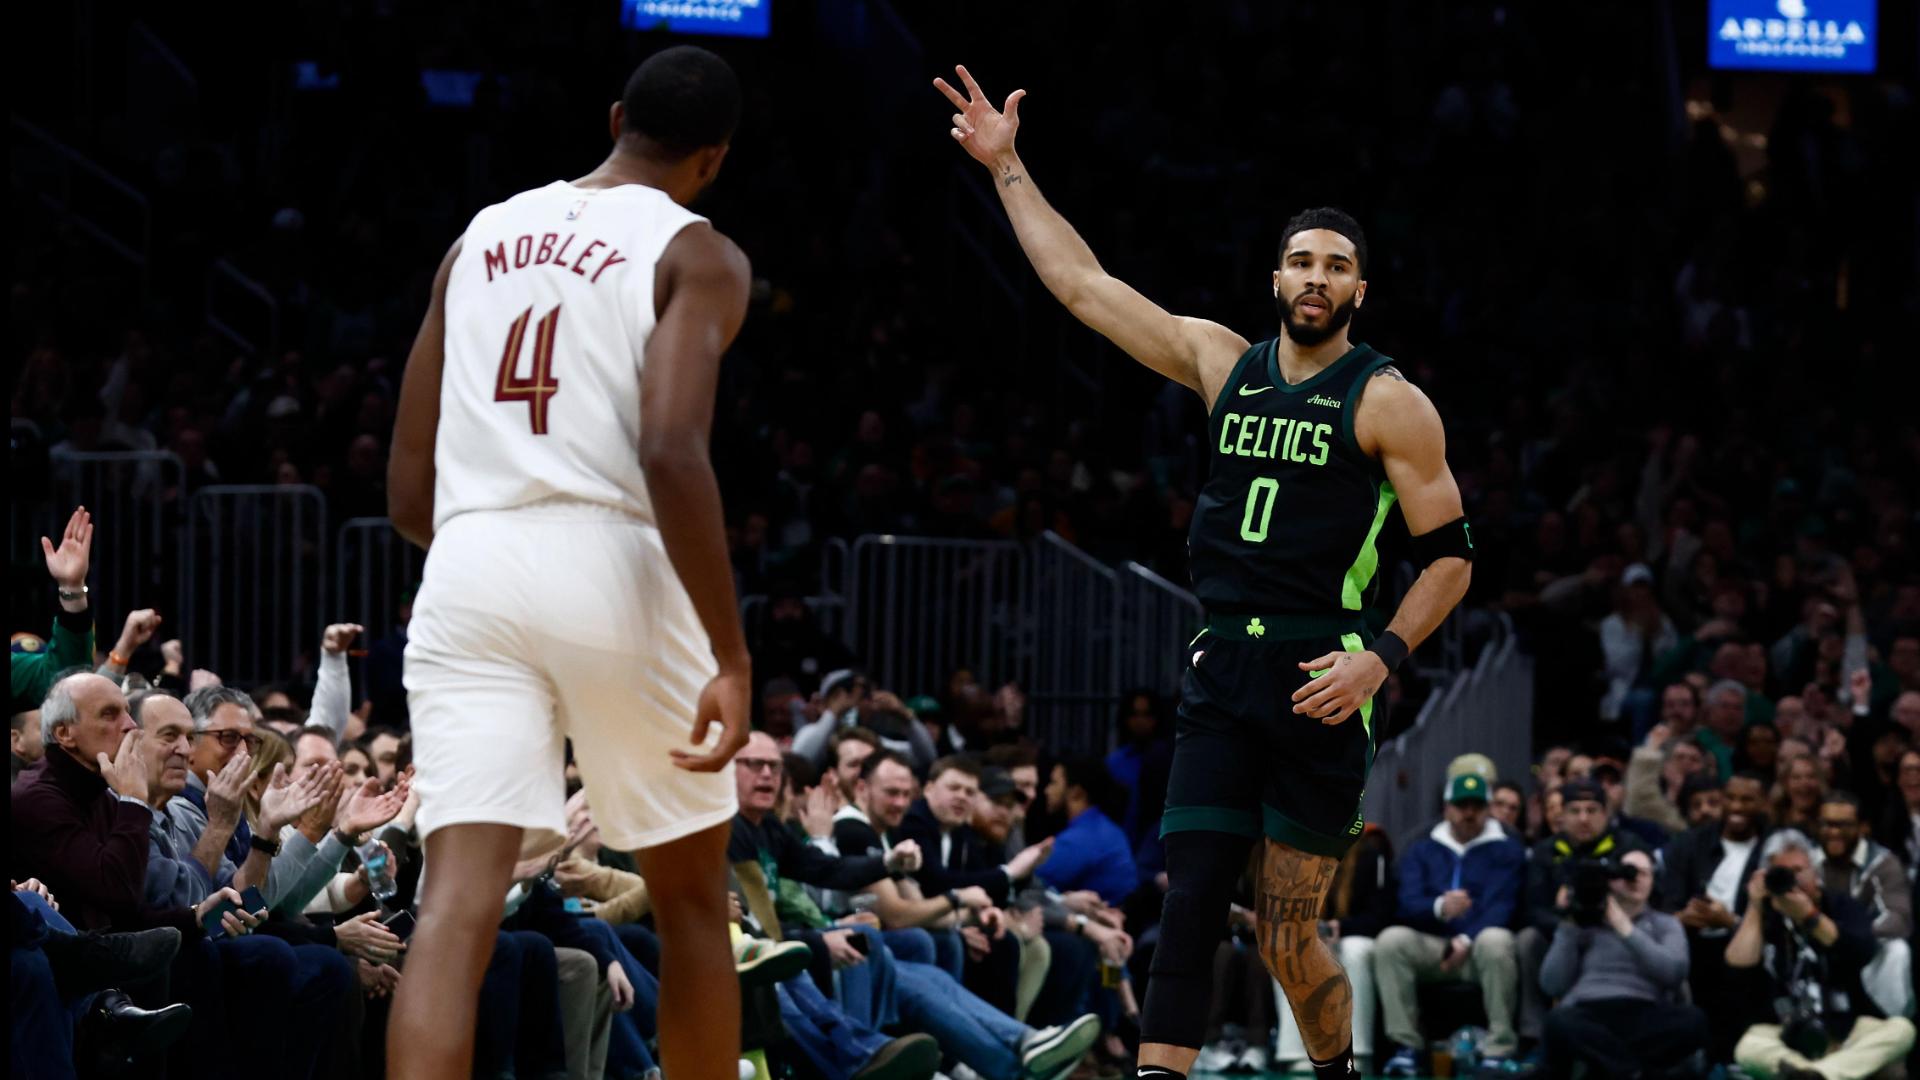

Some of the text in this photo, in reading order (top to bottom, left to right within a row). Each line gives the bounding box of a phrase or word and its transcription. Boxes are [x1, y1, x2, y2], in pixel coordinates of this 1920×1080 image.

[484, 232, 626, 283] MOBLEY
[494, 304, 560, 434] 4
[1306, 393, 1342, 409] Amica
[1218, 412, 1333, 466] CELTICS
[1240, 476, 1280, 543] 0
